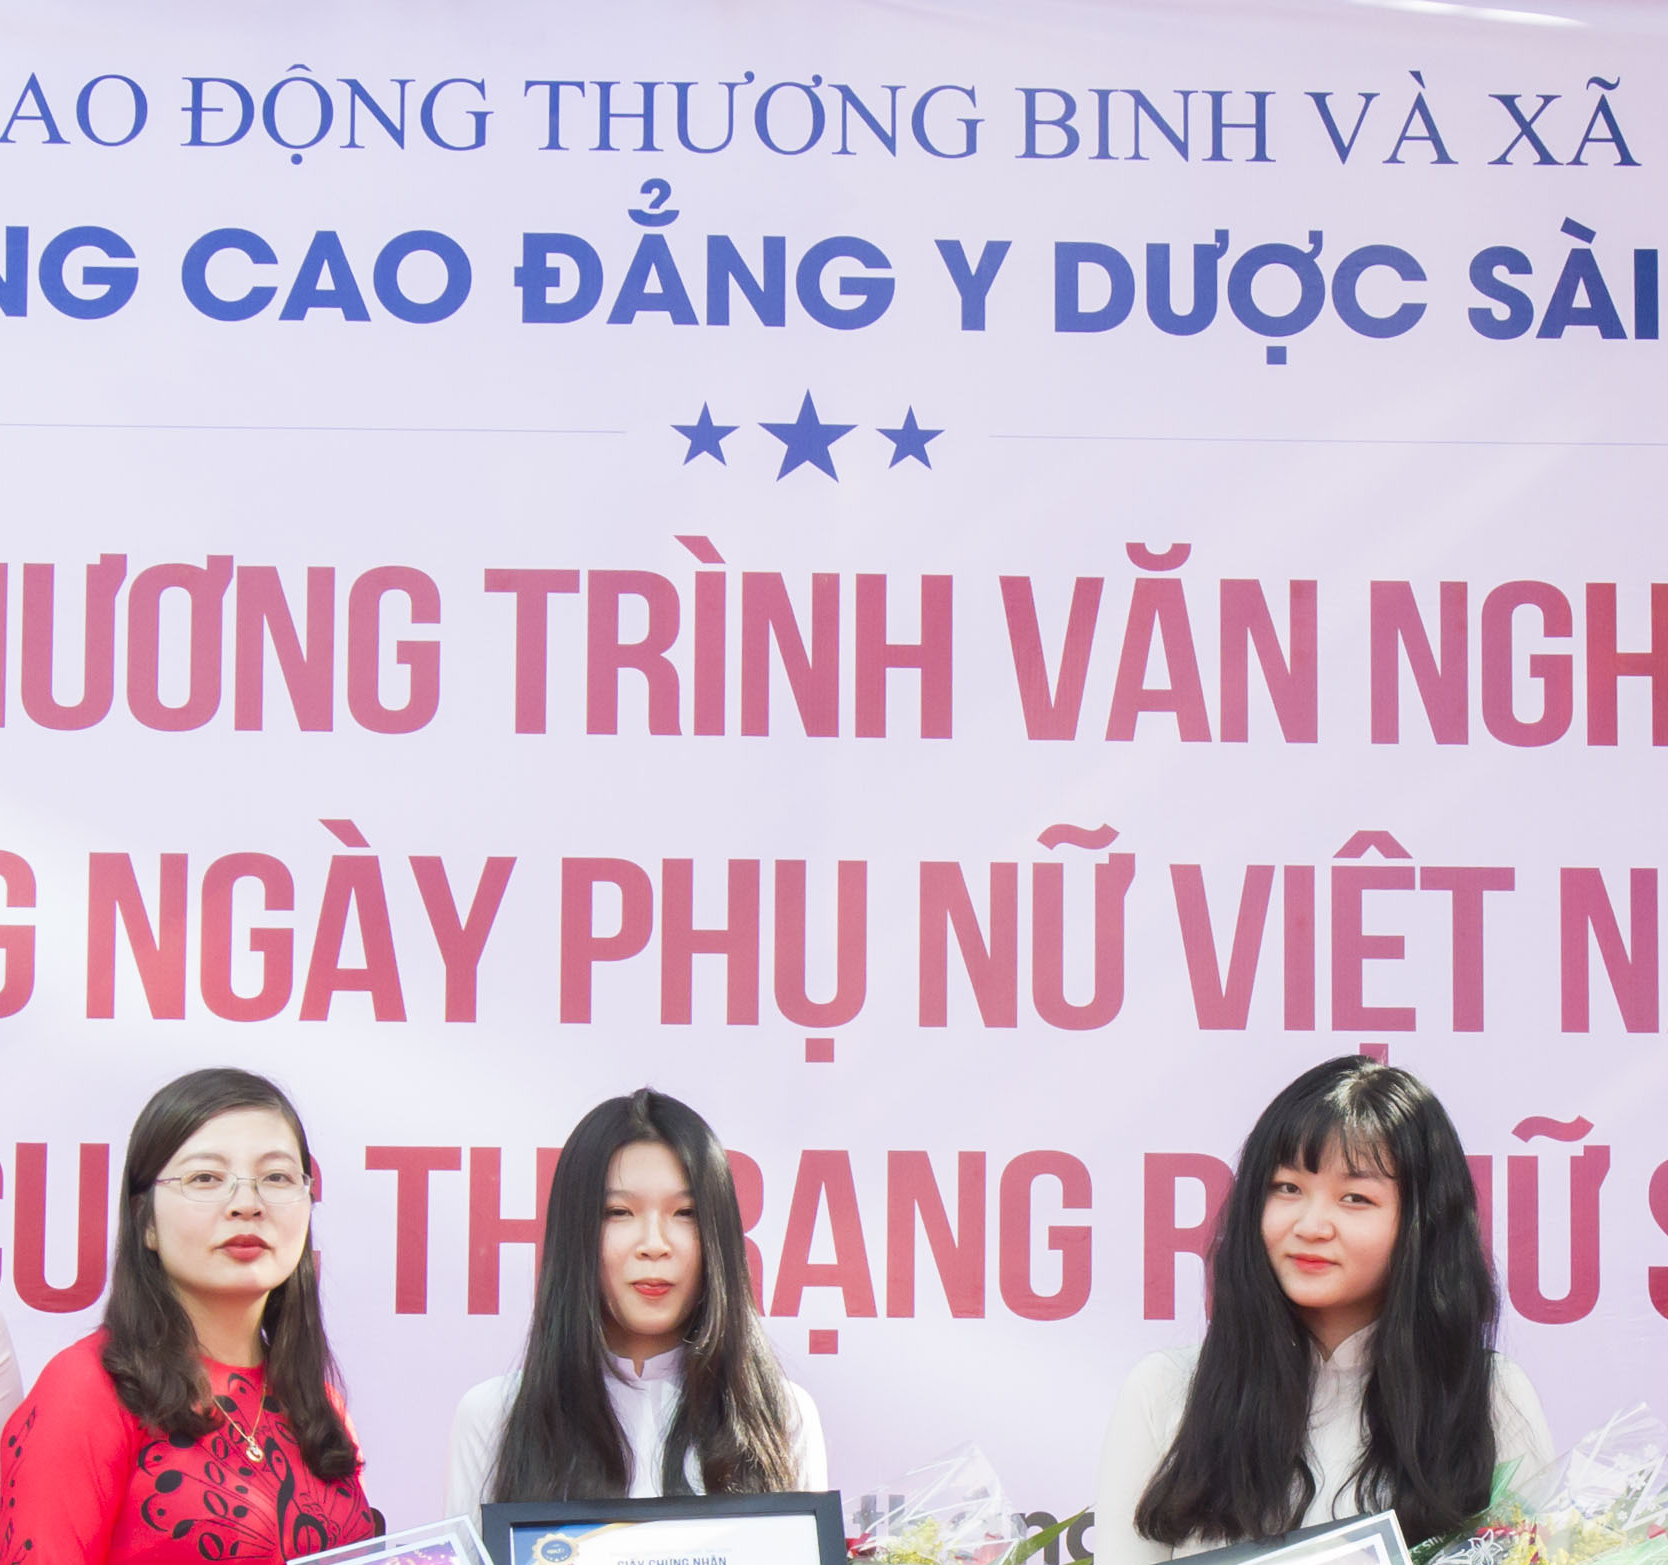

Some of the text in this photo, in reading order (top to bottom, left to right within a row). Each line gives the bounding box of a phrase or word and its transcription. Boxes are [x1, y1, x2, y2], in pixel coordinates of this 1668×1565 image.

[181, 64, 494, 166] ĐỘNG
[524, 70, 985, 160] THƯƠNG
[1014, 86, 1275, 165] BINH
[1304, 70, 1459, 167] VÀ
[1488, 76, 1642, 168] XÃ
[181, 227, 473, 324] CAO
[514, 178, 895, 330] ĐẲNG
[934, 238, 1013, 332] Y
[1054, 228, 1429, 366] DƯỢC
[1467, 216, 1660, 342] SÀI
[483, 535, 954, 741] TRÌNH
[998, 541, 1318, 746] VĂN
[86, 818, 517, 1023] NGÀY
[560, 857, 868, 1063] PHỤ
[919, 823, 1136, 1032] NỮ
[1170, 830, 1516, 1066] VIỆT
[365, 1145, 553, 1316] TH
